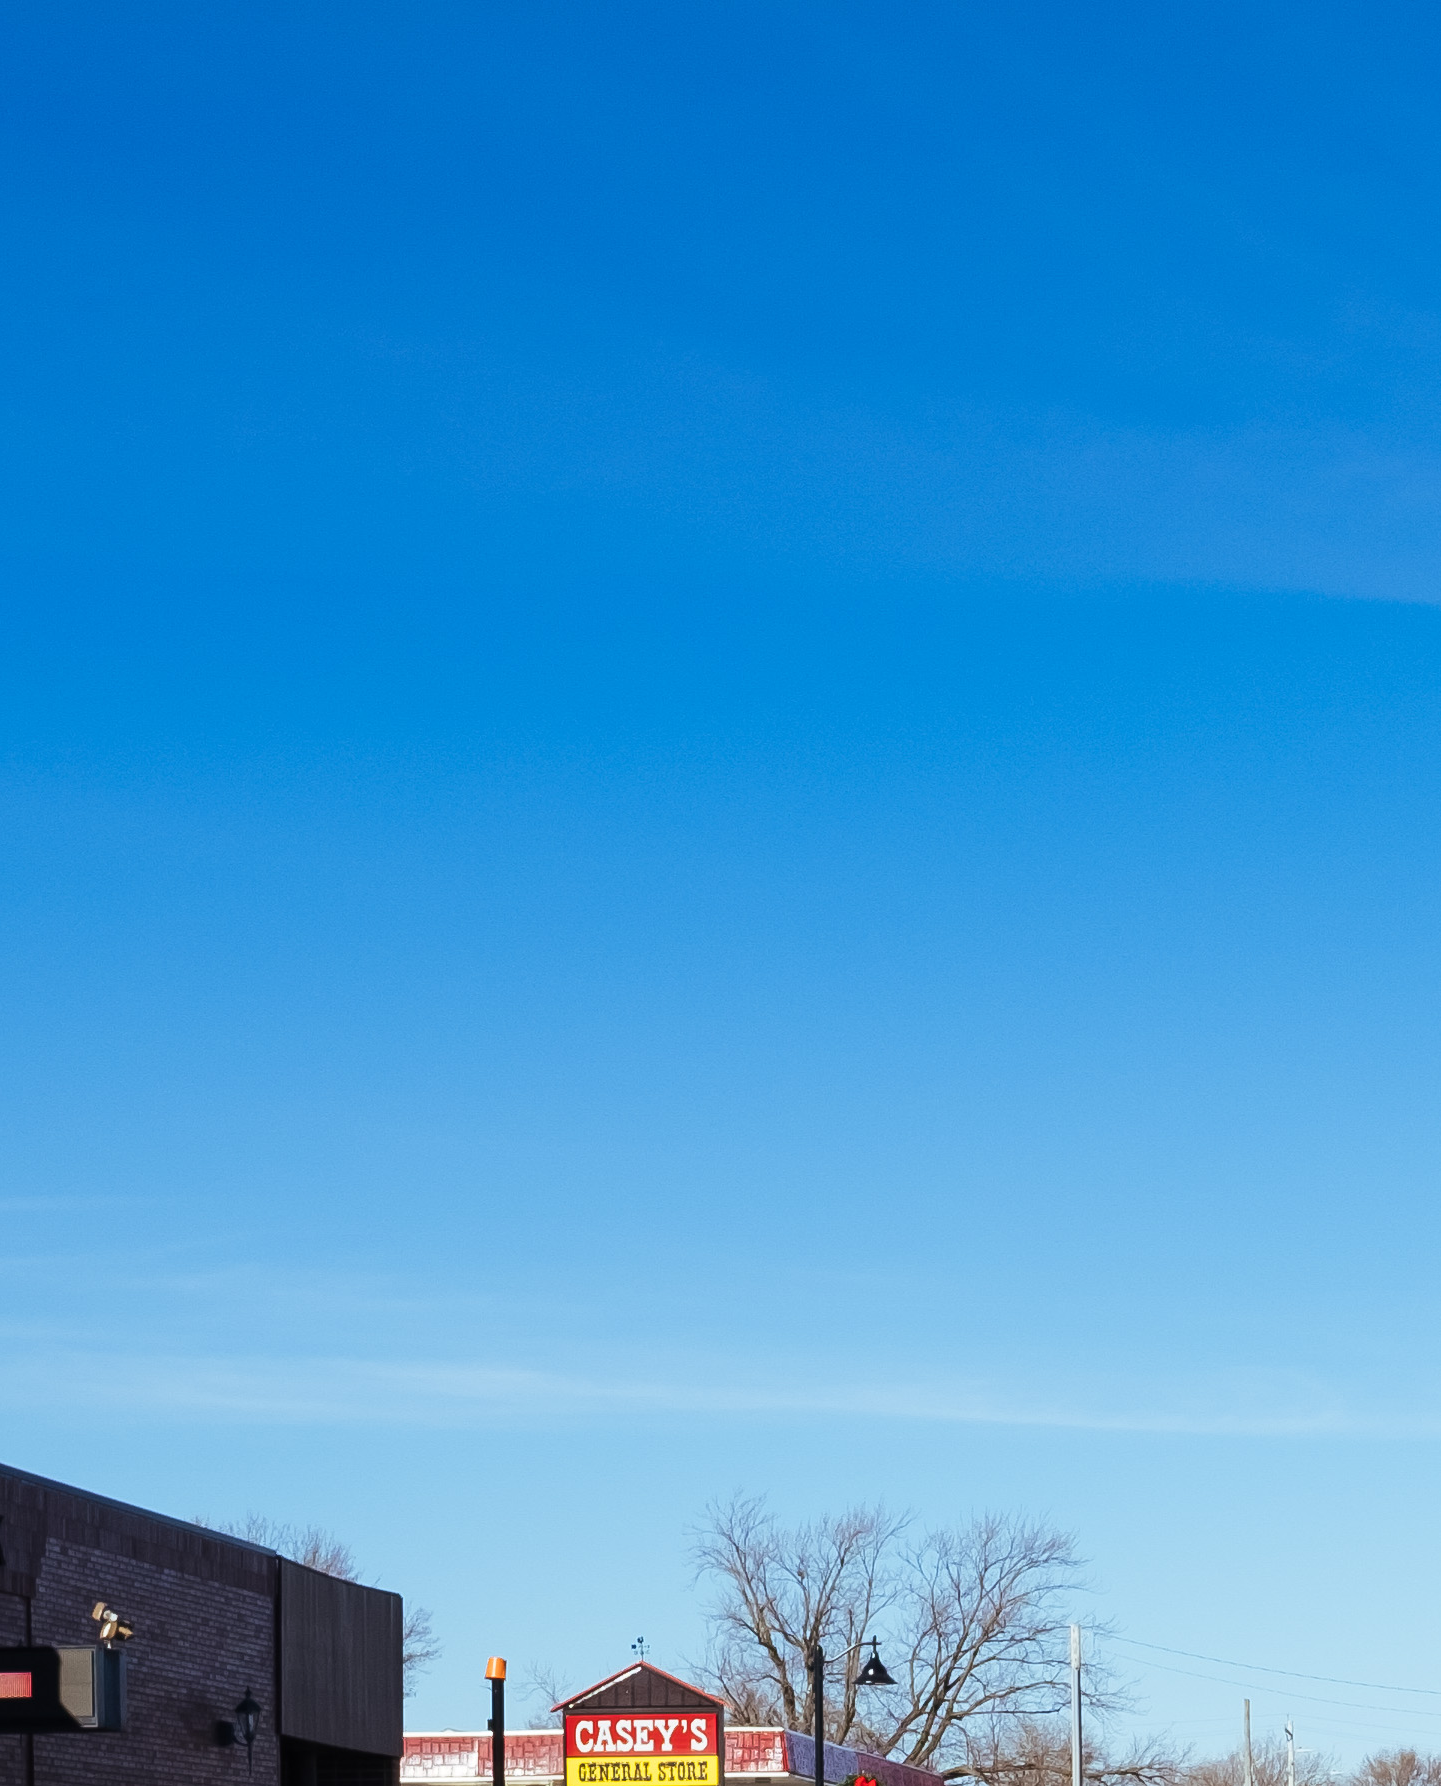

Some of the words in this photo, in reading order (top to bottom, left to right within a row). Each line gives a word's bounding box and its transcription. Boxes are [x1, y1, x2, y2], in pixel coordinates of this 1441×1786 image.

[575, 1718, 708, 1754] CASEY'S
[578, 1762, 652, 1783] GENERAL
[658, 1760, 708, 1782] STORE
